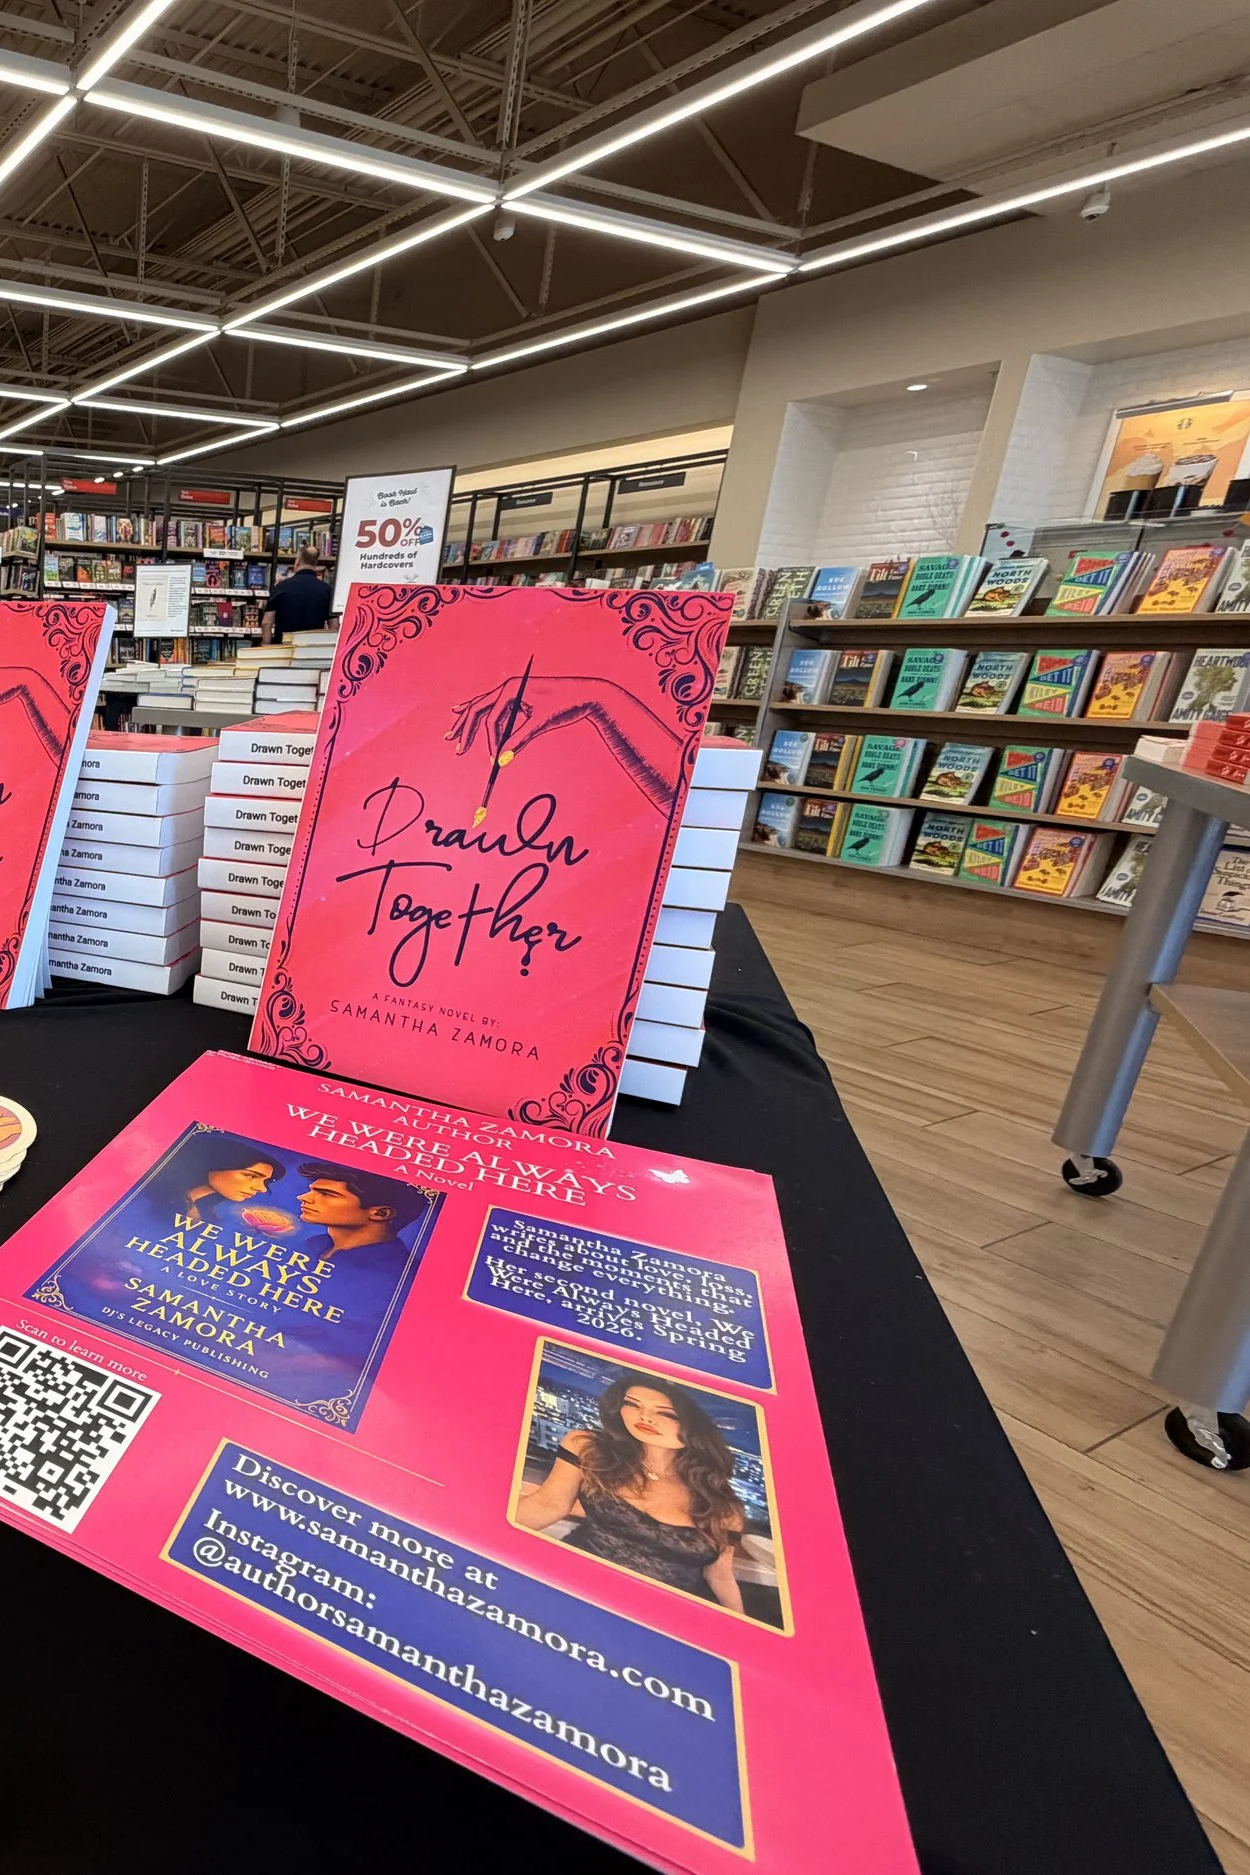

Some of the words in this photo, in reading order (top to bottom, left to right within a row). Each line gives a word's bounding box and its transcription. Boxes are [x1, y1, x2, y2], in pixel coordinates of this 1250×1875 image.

[377, 490, 398, 500] Book
[398, 487, 418, 497] Haul
[354, 517, 423, 549] 50%
[399, 538, 421, 547] OFF
[359, 551, 405, 561] Hundreds
[406, 550, 419, 560] of
[360, 561, 414, 570] Hardcovers
[869, 568, 889, 582] Tilt
[985, 577, 1029, 586] WOODS
[992, 569, 1033, 579] NORTH
[842, 655, 860, 668] Tilt
[977, 663, 1014, 672] NORTH
[971, 672, 1011, 681] WOODS
[1172, 708, 1203, 721] AMITY
[251, 743, 283, 755] Drawn
[815, 738, 830, 752] Tilt
[937, 761, 978, 773] WOODS
[942, 755, 981, 765] NORTH
[243, 775, 275, 787] Drawn
[71, 820, 104, 832] Zamora
[235, 809, 267, 822] Drawn
[357, 776, 589, 867] Drawn
[922, 831, 964, 843] WOODS
[926, 823, 966, 835] NORTH
[71, 850, 103, 862] Zamora
[234, 840, 265, 853] Drawn
[228, 872, 259, 885] Drawn
[1223, 862, 1242, 873] List
[74, 878, 106, 892] Zamora
[76, 907, 108, 920] Zamora
[335, 860, 583, 988] Together
[77, 934, 109, 948] Zamora
[80, 962, 112, 977] Zamora
[229, 962, 259, 976] Drawn
[220, 990, 250, 1005] Drawn
[372, 992, 379, 1000] A
[384, 994, 434, 1013] FANTASY
[439, 1007, 475, 1023] NOVEL
[481, 1016, 501, 1029] BY:
[330, 999, 438, 1037] SAMANTHA
[451, 1027, 540, 1061] ZAMORA
[318, 1082, 469, 1127] SAMANTHA
[479, 1118, 617, 1159] ZAMORA
[393, 1114, 514, 1151] AUTHOR
[286, 1103, 338, 1128] WE
[348, 1121, 451, 1157] WERE
[459, 1150, 637, 1203] ALWAYS
[308, 1126, 465, 1174] HEADED
[477, 1168, 588, 1207] HERE
[393, 1163, 411, 1175] A
[414, 1168, 475, 1192] Novel
[173, 1213, 223, 1240] WE
[234, 1231, 336, 1280] WERE
[513, 1219, 622, 1257] Samantha
[631, 1250, 727, 1283] Zamora
[160, 1231, 322, 1295] ALWAYS
[490, 1233, 530, 1249] and
[538, 1244, 574, 1261] the
[582, 1257, 691, 1293] moments
[700, 1287, 753, 1309] that
[491, 1223, 557, 1248] writes
[563, 1242, 630, 1268] about
[637, 1257, 693, 1285] love,
[701, 1275, 754, 1300] loss,
[124, 1236, 251, 1289] HEADED
[258, 1282, 346, 1325] HERE
[160, 1265, 171, 1274] A
[178, 1271, 220, 1291] LOVE
[226, 1289, 283, 1315] STORY
[503, 1244, 584, 1274] change
[592, 1269, 735, 1316] everything.
[484, 1255, 528, 1276] Her
[534, 1272, 615, 1301] second
[624, 1297, 702, 1328] novel,
[710, 1318, 756, 1340] We
[488, 1266, 544, 1290] Were
[552, 1286, 642, 1320] Always
[649, 1312, 752, 1351] Headed
[124, 1277, 286, 1349] SAMANTHA
[489, 1276, 553, 1305] Here,
[561, 1300, 645, 1331] arrives
[653, 1324, 747, 1364] Spring
[130, 1296, 256, 1357] ZAMORA
[576, 1313, 643, 1342] 2026.
[15, 1318, 49, 1340] Scan
[51, 1335, 67, 1348] to
[69, 1340, 104, 1363] learn
[107, 1358, 148, 1382] more
[101, 1306, 127, 1321] DJ'S
[128, 1317, 181, 1342] LEGACY
[183, 1339, 270, 1380] PUBLISHING
[232, 1452, 363, 1527] Discover
[368, 1517, 455, 1571] more
[464, 1561, 500, 1591] at
[202, 1508, 376, 1611] Instagram:
[223, 1478, 716, 1722] www.samanthazamora.com
[191, 1536, 674, 1793] @authorsamanthazamora
